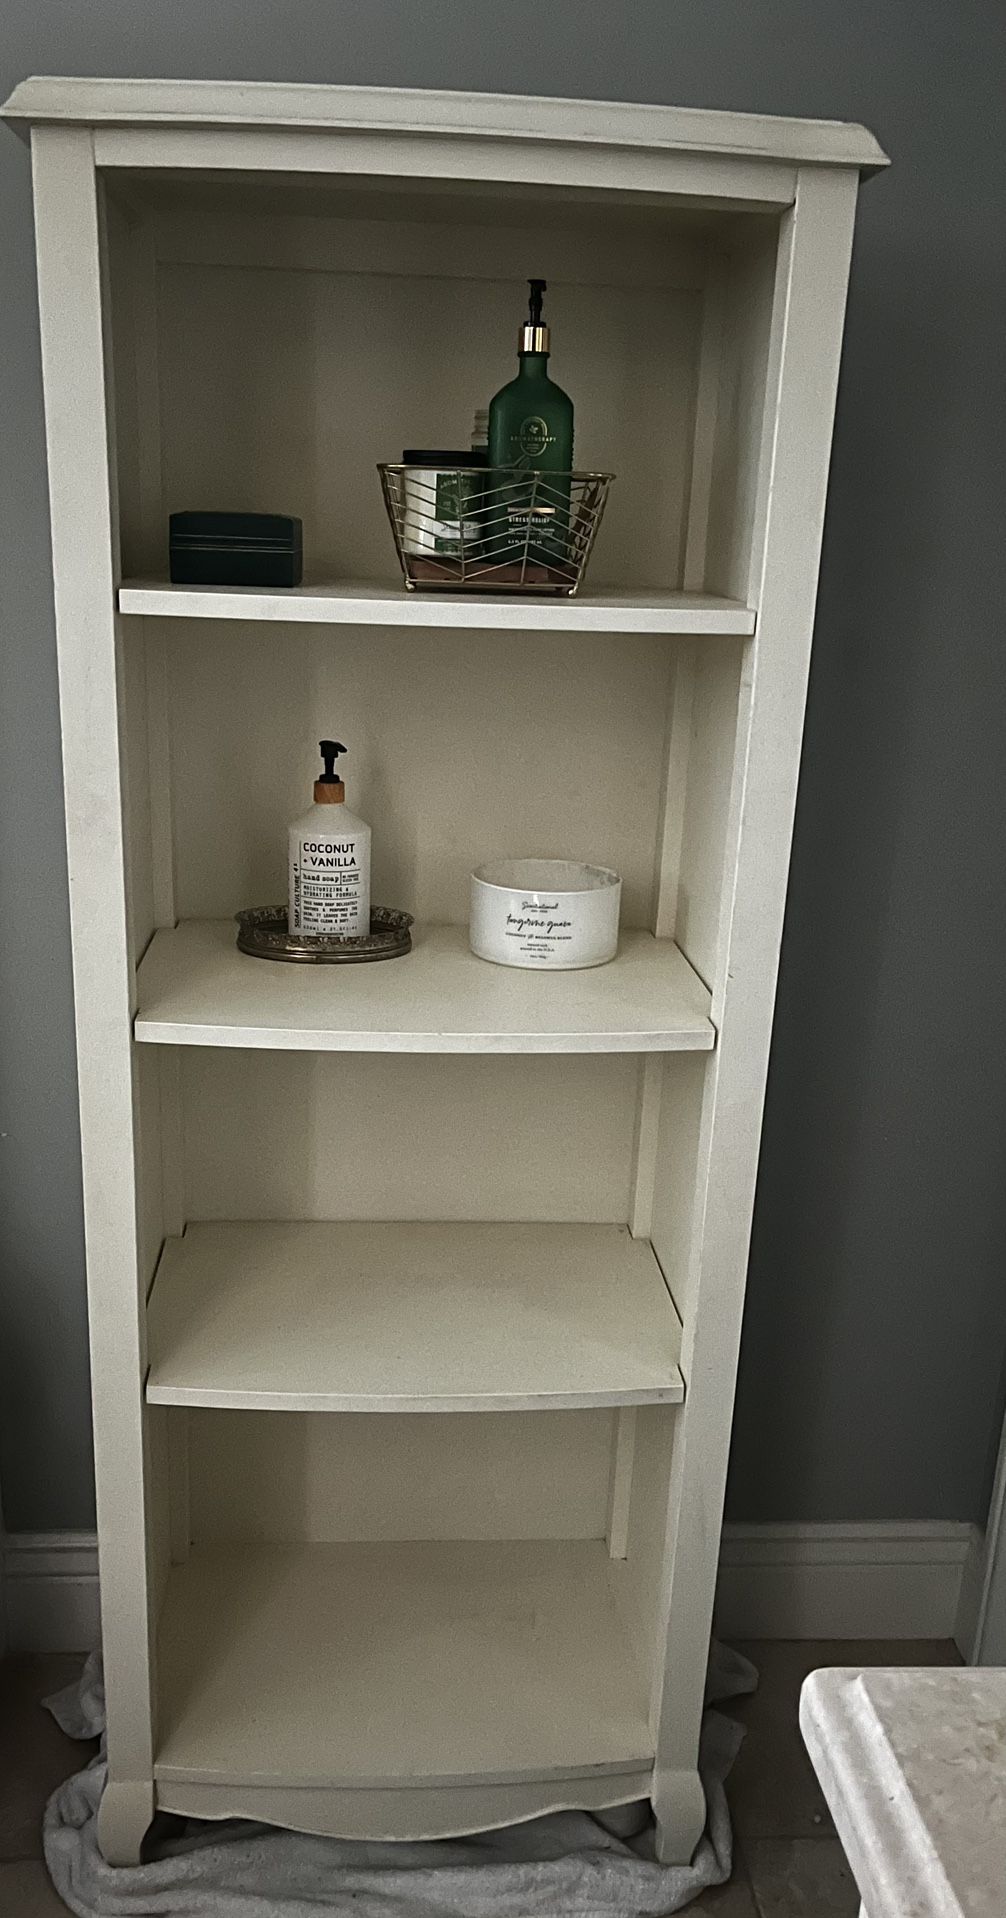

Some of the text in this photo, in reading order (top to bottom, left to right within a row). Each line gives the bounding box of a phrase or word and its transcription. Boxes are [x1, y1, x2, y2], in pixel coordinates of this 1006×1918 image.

[303, 842, 355, 853] COCONUT
[310, 856, 356, 867] VANILLA
[303, 873, 320, 881] hand
[547, 920, 572, 934] guava
